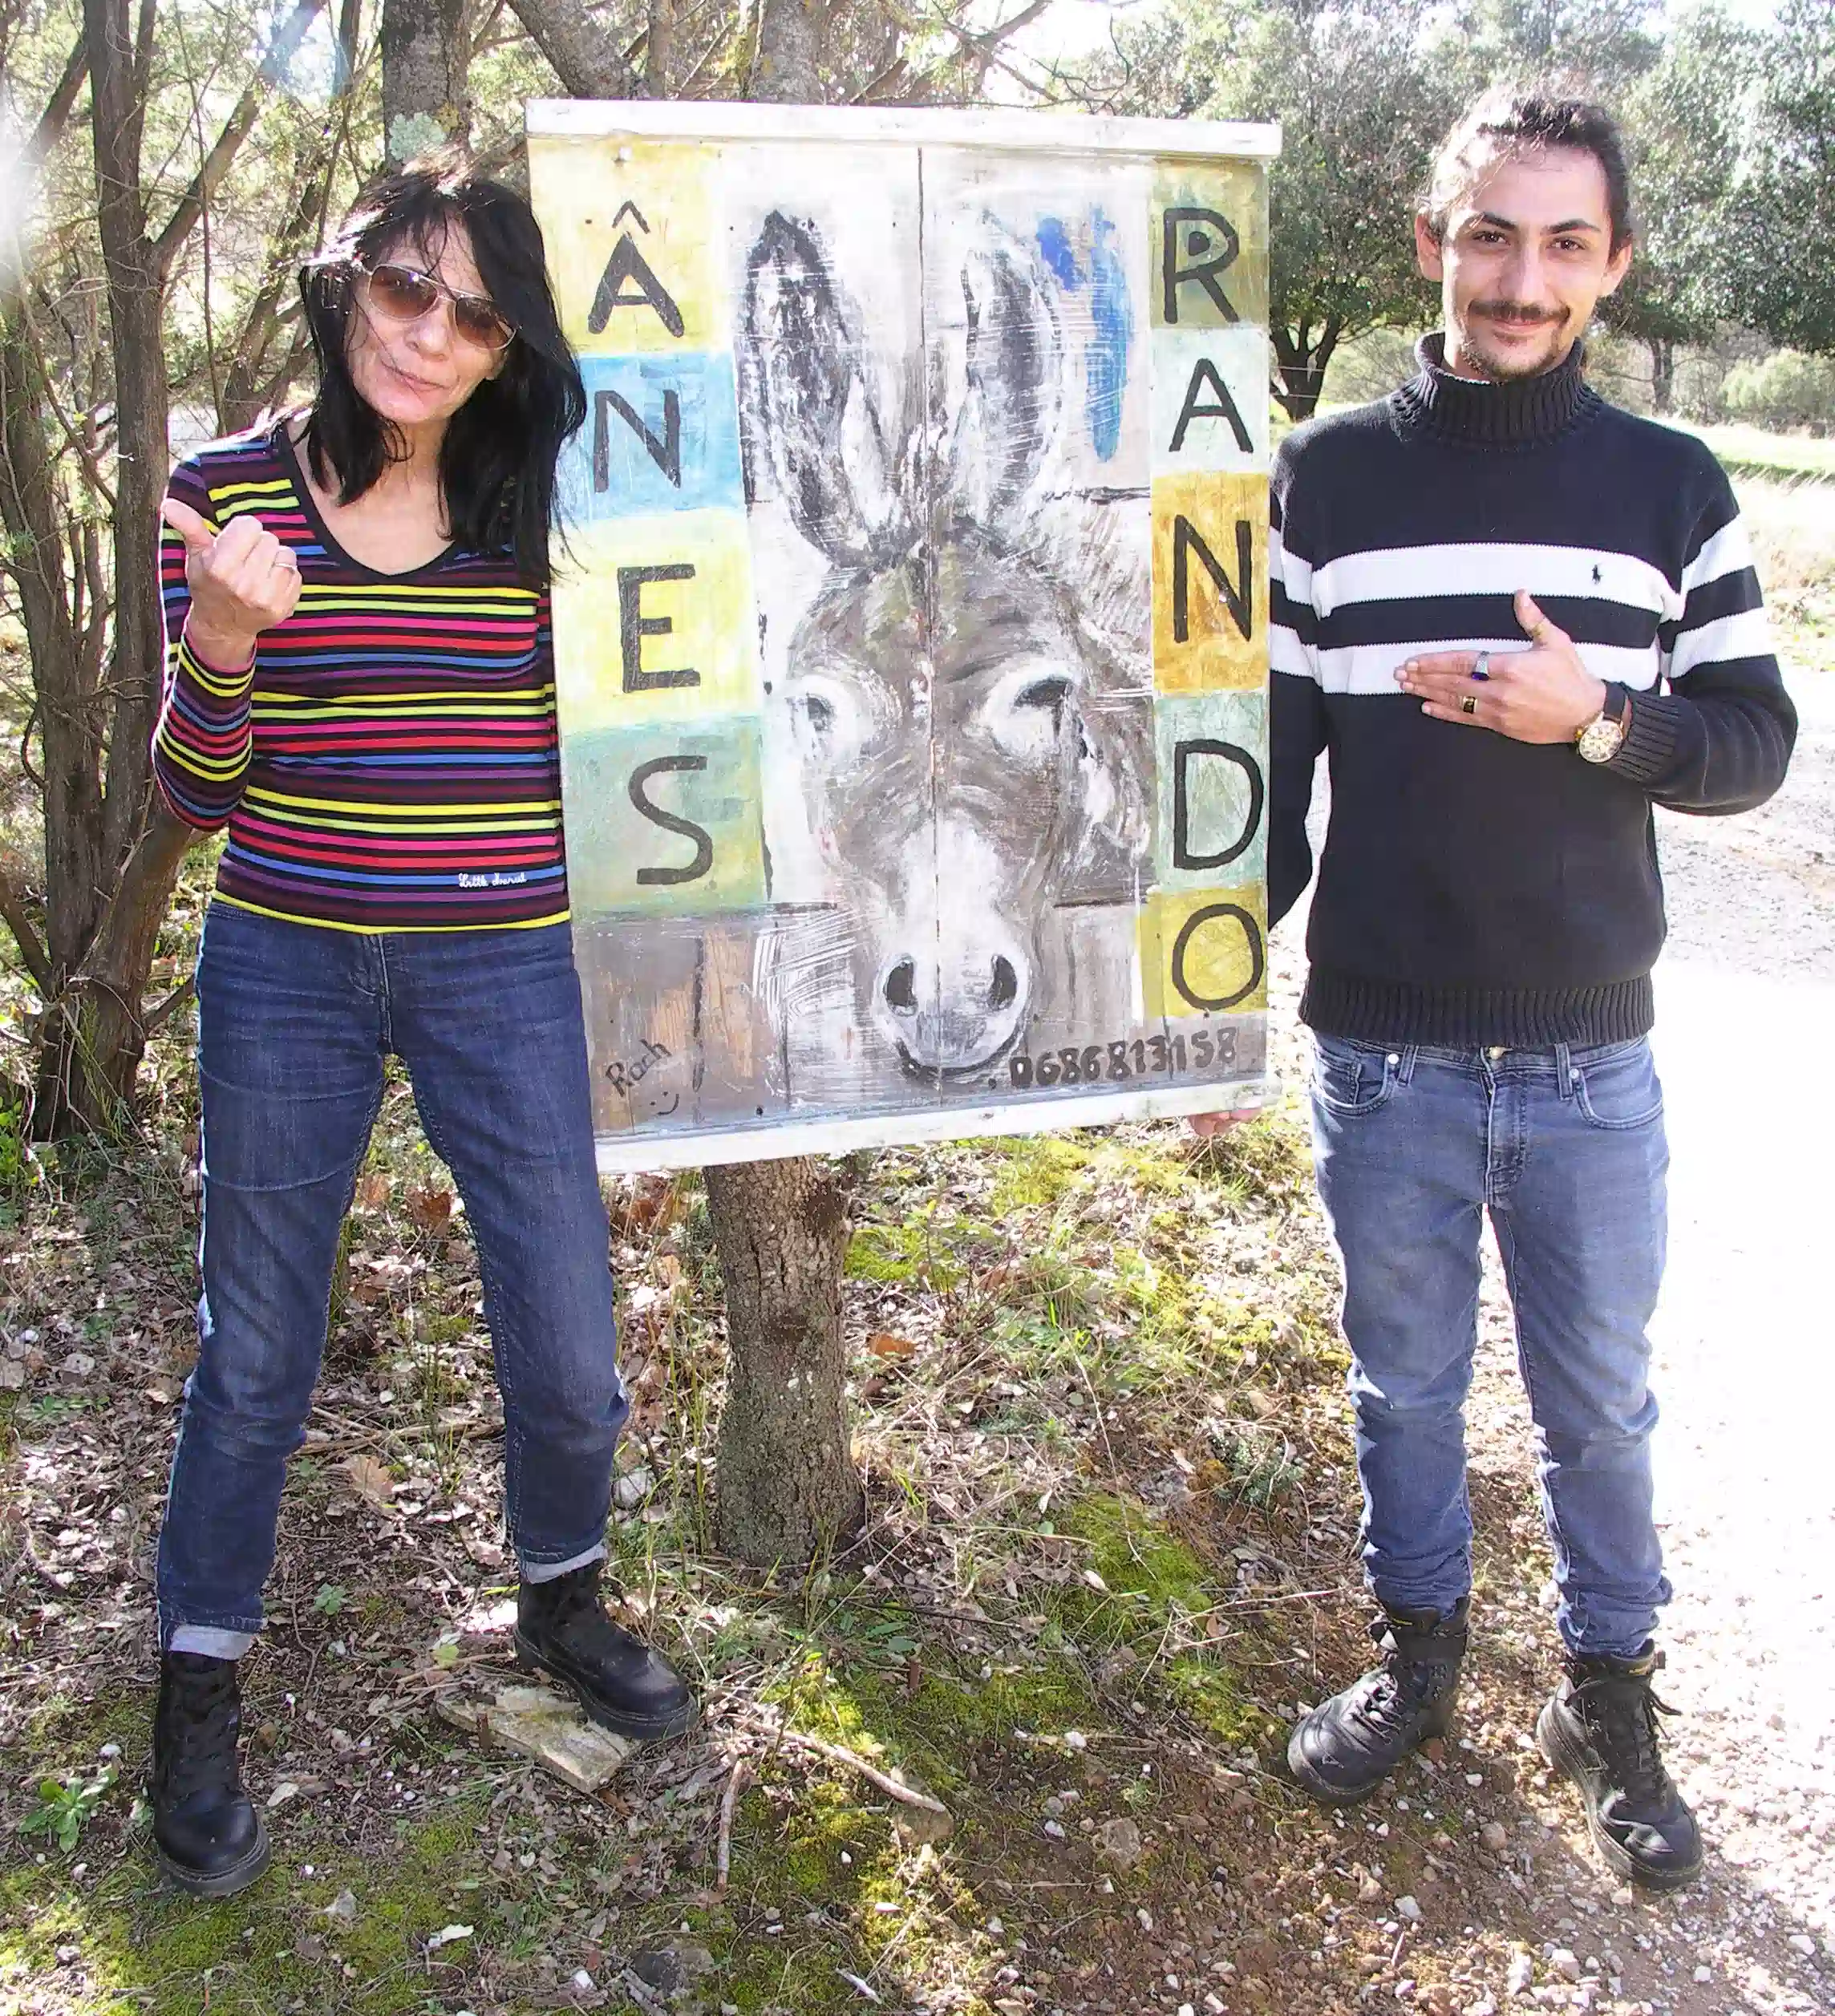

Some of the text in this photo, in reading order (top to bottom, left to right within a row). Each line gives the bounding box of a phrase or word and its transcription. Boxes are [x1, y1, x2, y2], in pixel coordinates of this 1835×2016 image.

[587, 200, 713, 886] ÂNES
[1163, 207, 1264, 1011] RANDO
[1010, 1027, 1237, 1089] 0686813158
